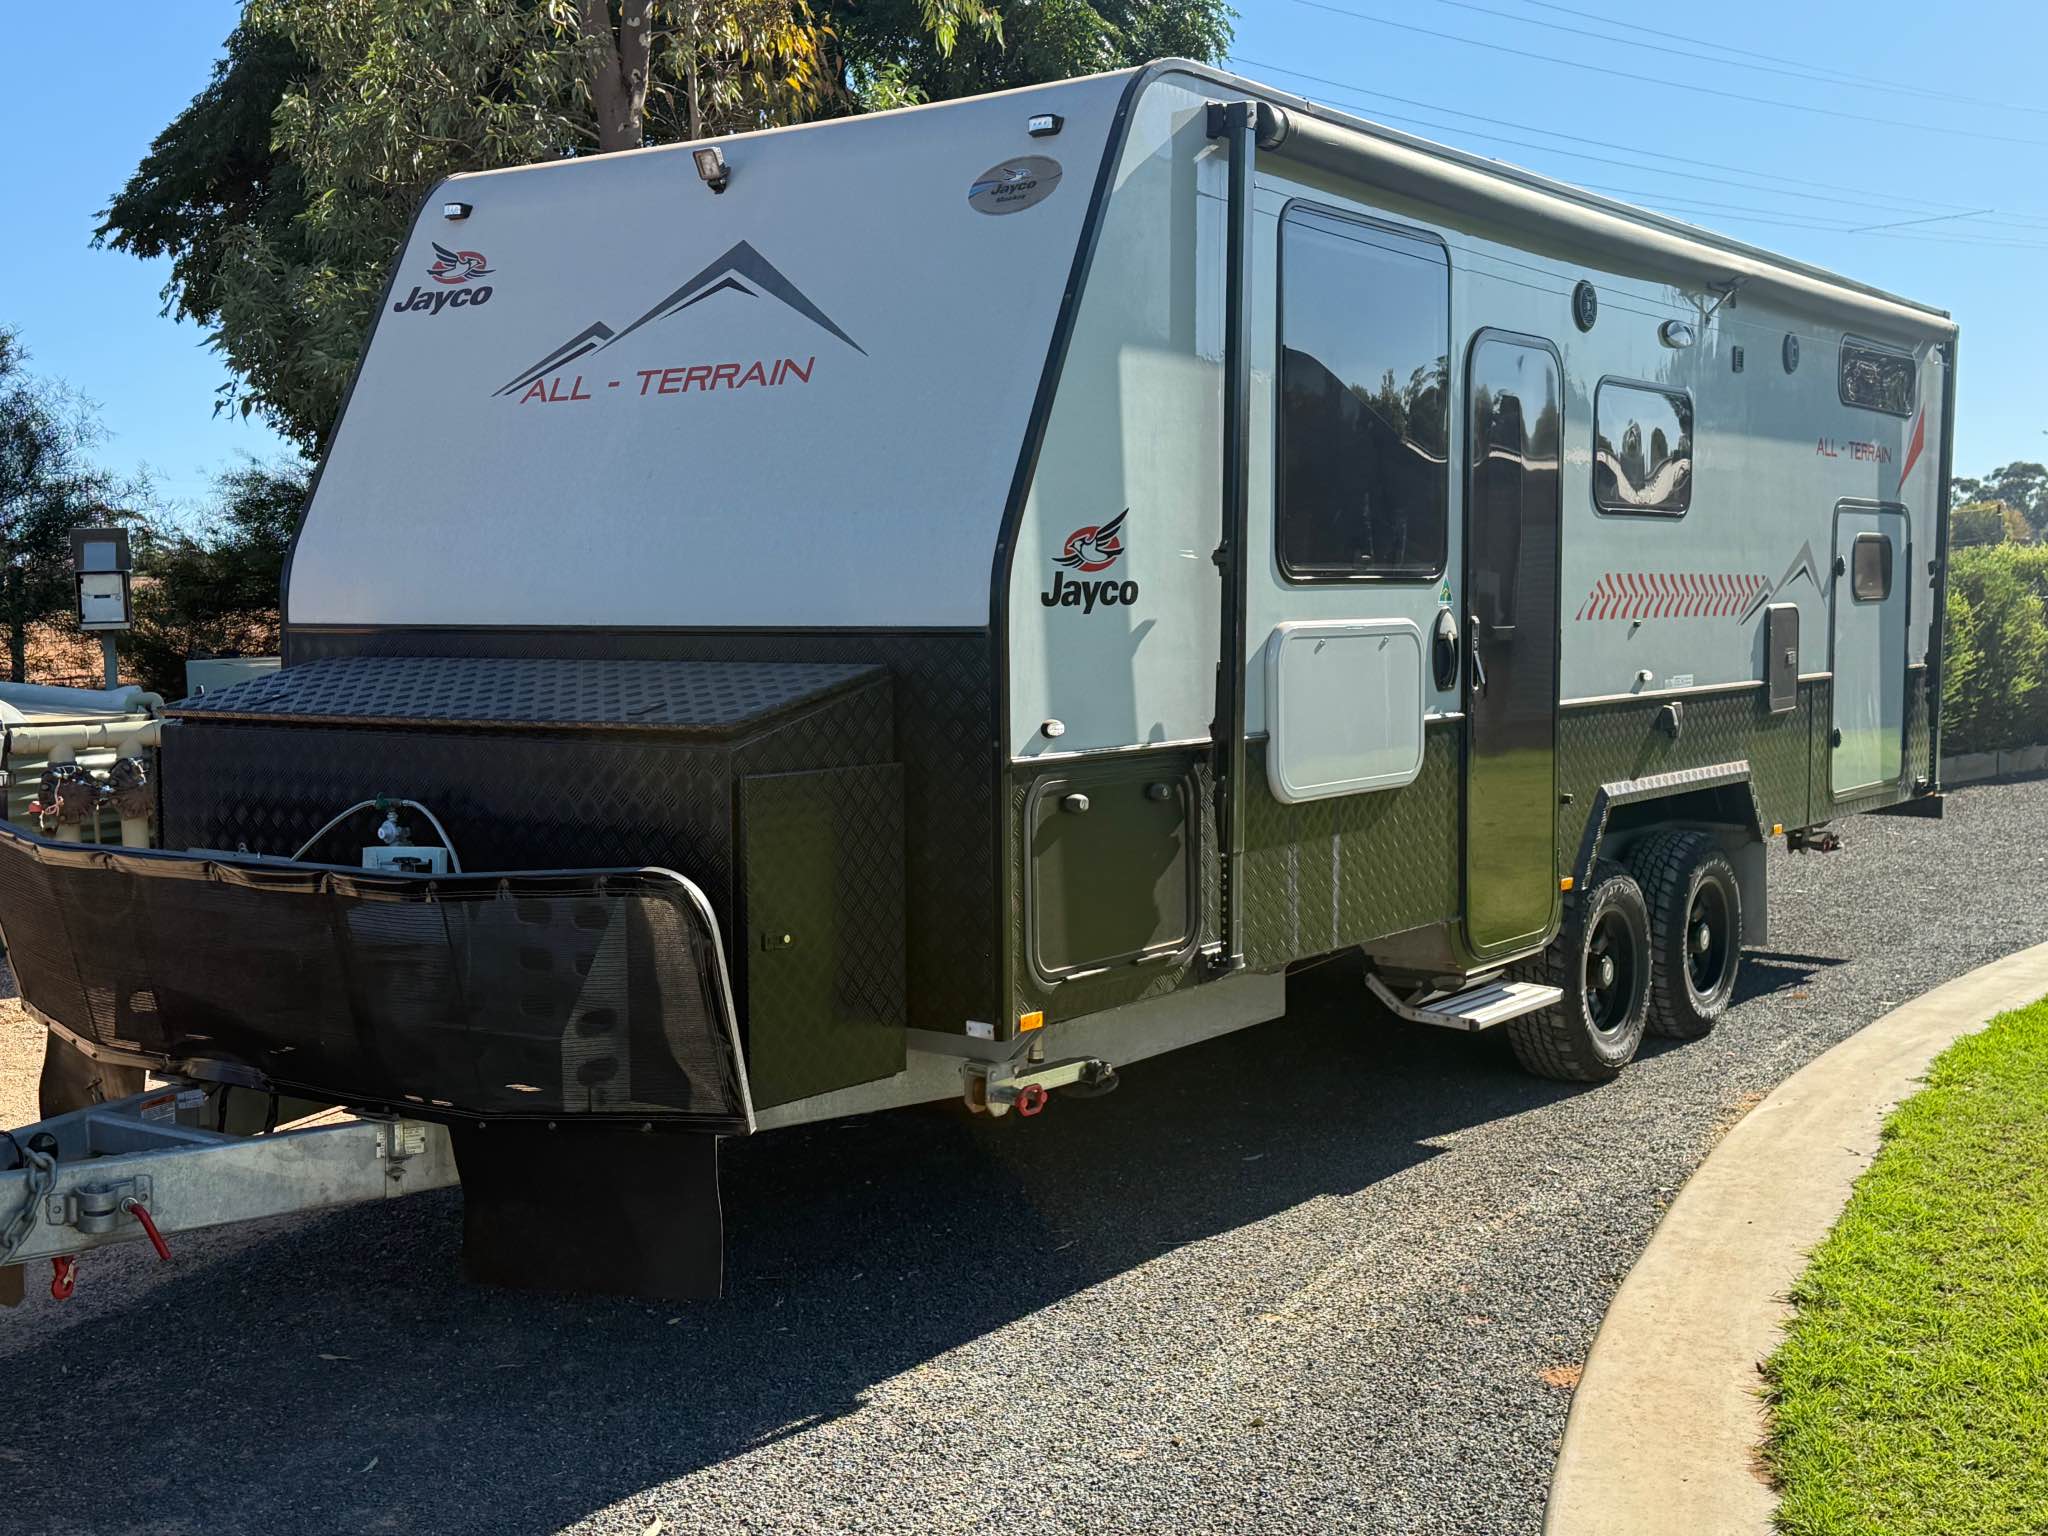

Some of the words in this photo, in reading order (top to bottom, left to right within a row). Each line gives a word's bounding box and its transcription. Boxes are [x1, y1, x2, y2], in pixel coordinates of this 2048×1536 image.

[991, 181, 1036, 195] Jayco
[394, 287, 493, 316] Jayco
[520, 376, 591, 404] ALL
[637, 357, 815, 396] TERRAIN
[1816, 437, 1838, 457] ALL
[1849, 441, 1892, 464] TERRAIN
[1041, 571, 1139, 614] Jayco
